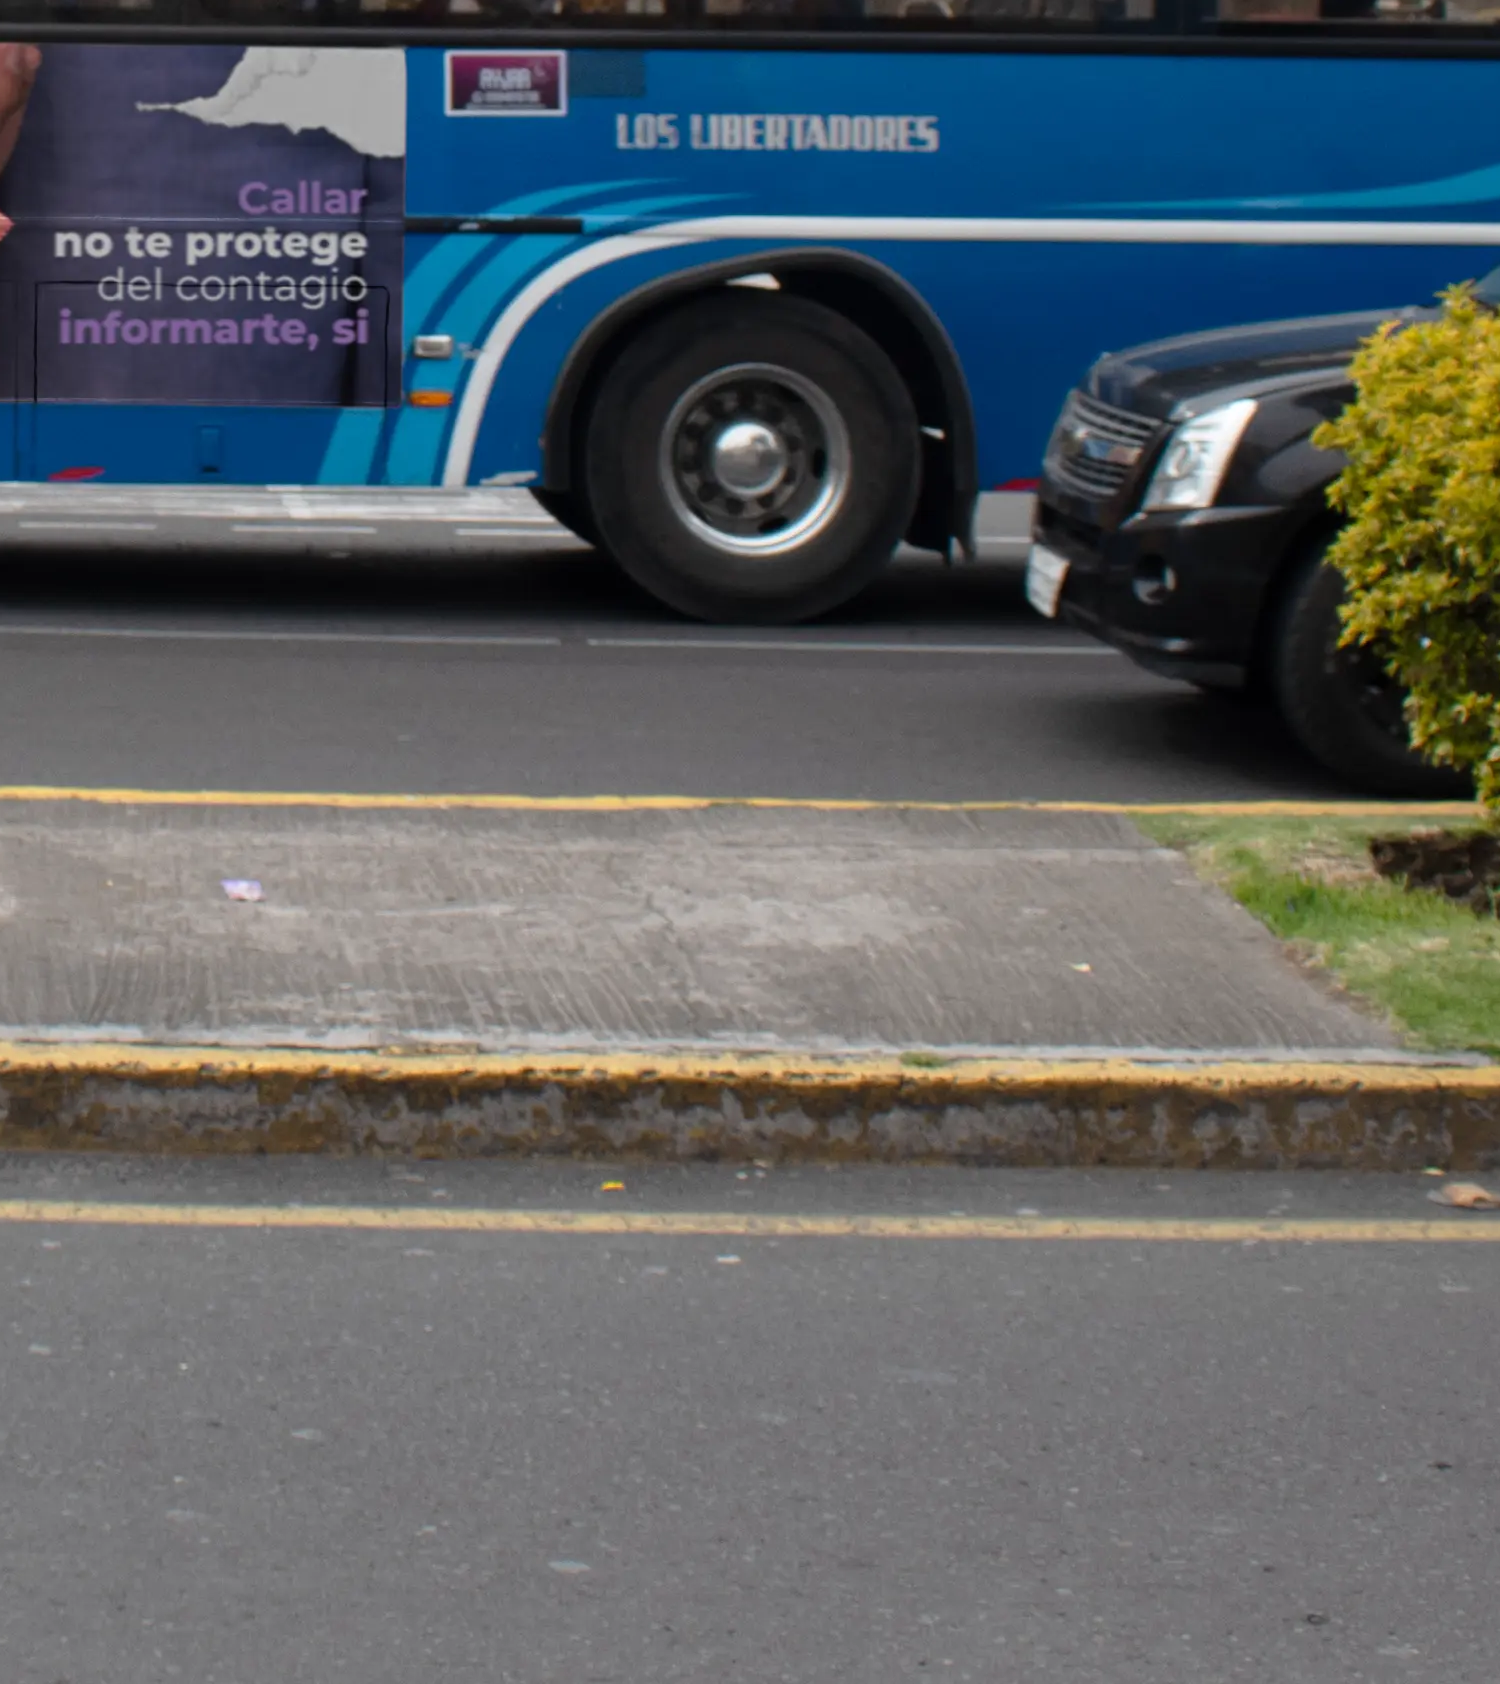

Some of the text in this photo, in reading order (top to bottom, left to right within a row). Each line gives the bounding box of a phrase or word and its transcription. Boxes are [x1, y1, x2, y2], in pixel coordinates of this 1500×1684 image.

[615, 113, 941, 153] LOS LIBERTADORES
[238, 180, 369, 215] Callar
[53, 226, 369, 266] no te protege
[97, 266, 369, 310] del contagio
[58, 308, 370, 352] informarte, si
